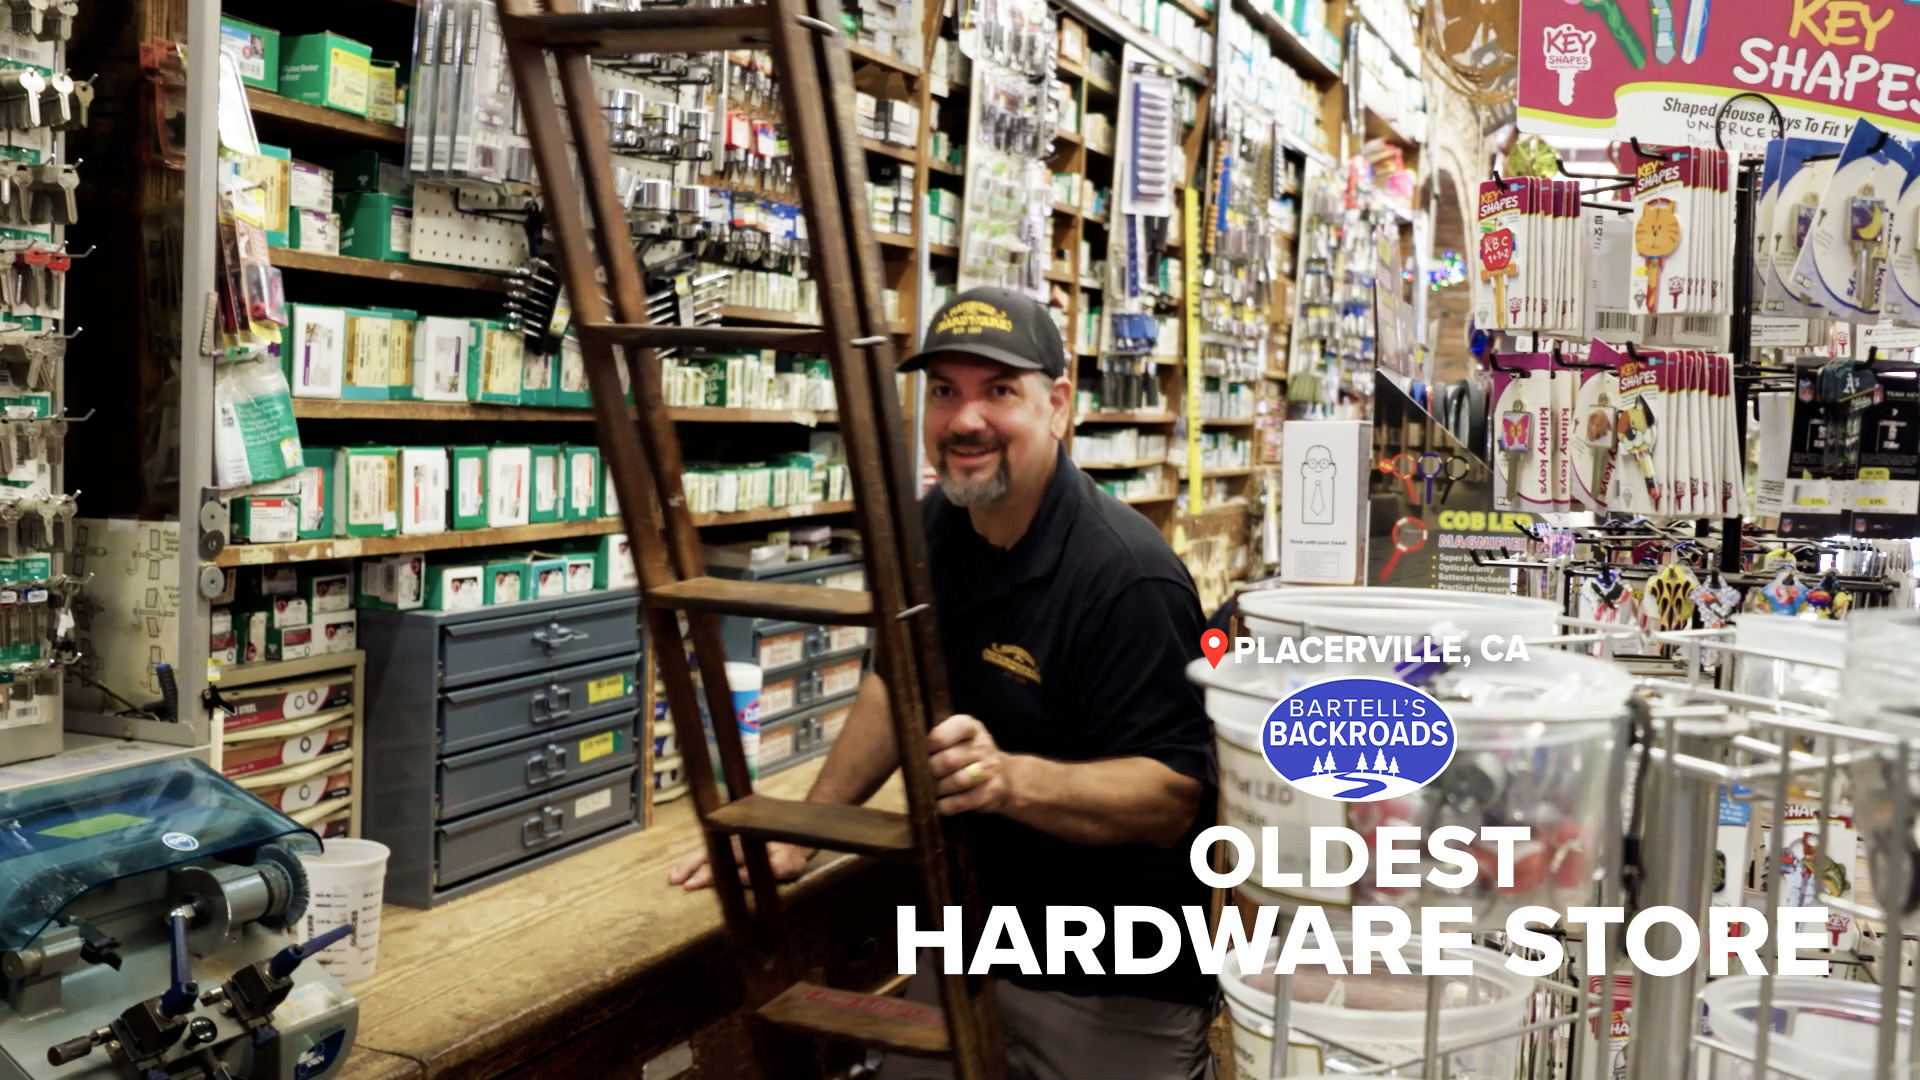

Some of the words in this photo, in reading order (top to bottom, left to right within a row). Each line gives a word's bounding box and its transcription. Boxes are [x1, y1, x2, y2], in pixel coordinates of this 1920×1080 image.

[1789, 0, 1894, 52] KEY
[1547, 30, 1592, 54] KEY
[1548, 55, 1588, 65] SHAPES
[1663, 97, 1717, 118] Shaped
[1720, 104, 1765, 124] House
[1769, 109, 1801, 130] Keys
[1805, 117, 1819, 133] To
[1821, 120, 1840, 136] Fit
[1638, 160, 1659, 178] KEY
[1638, 166, 1680, 192] SHAPES
[1480, 190, 1499, 206] KEY
[1480, 195, 1518, 217] SHAPES
[1620, 362, 1639, 377] KEY
[1620, 370, 1657, 390] SHAPES
[1538, 407, 1549, 456] klinky
[1560, 407, 1570, 456] klinky
[1538, 459, 1549, 495] keys
[1560, 459, 1569, 495] keys
[1438, 510, 1486, 531] COB
[1487, 511, 1533, 533] LED
[1438, 563, 1468, 573] Optical
[1469, 564, 1495, 575] clarity
[1439, 553, 1463, 563] Super
[1438, 573, 1475, 582] Batteries
[1476, 574, 1510, 583] include
[1438, 582, 1473, 592] Practical
[1475, 583, 1486, 592] for
